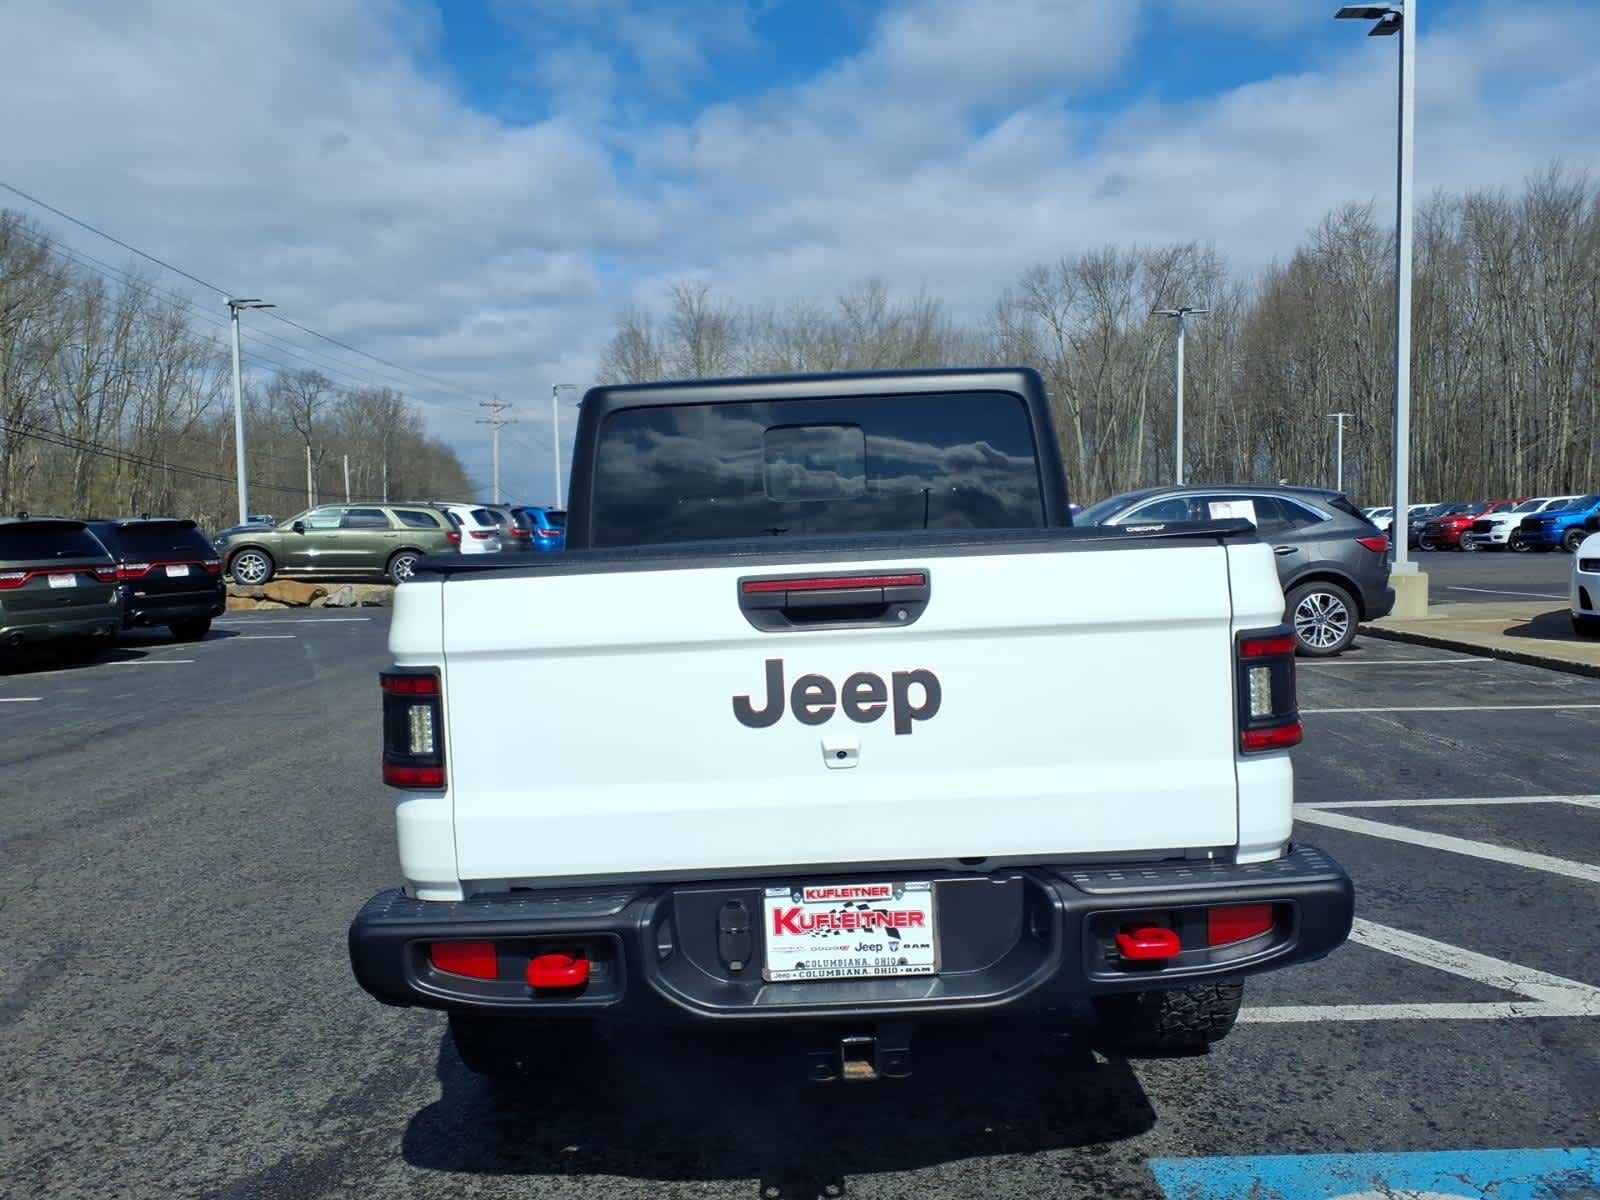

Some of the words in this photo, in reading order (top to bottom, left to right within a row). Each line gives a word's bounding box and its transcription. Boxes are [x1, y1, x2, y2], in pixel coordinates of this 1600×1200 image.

[732, 658, 942, 735] Jeep
[805, 886, 890, 900] KUFLEITNER
[773, 906, 925, 937] KUFLEITNER
[854, 941, 883, 953] Jeep
[874, 956, 897, 966] OHIO
[874, 966, 898, 976] OHIO
